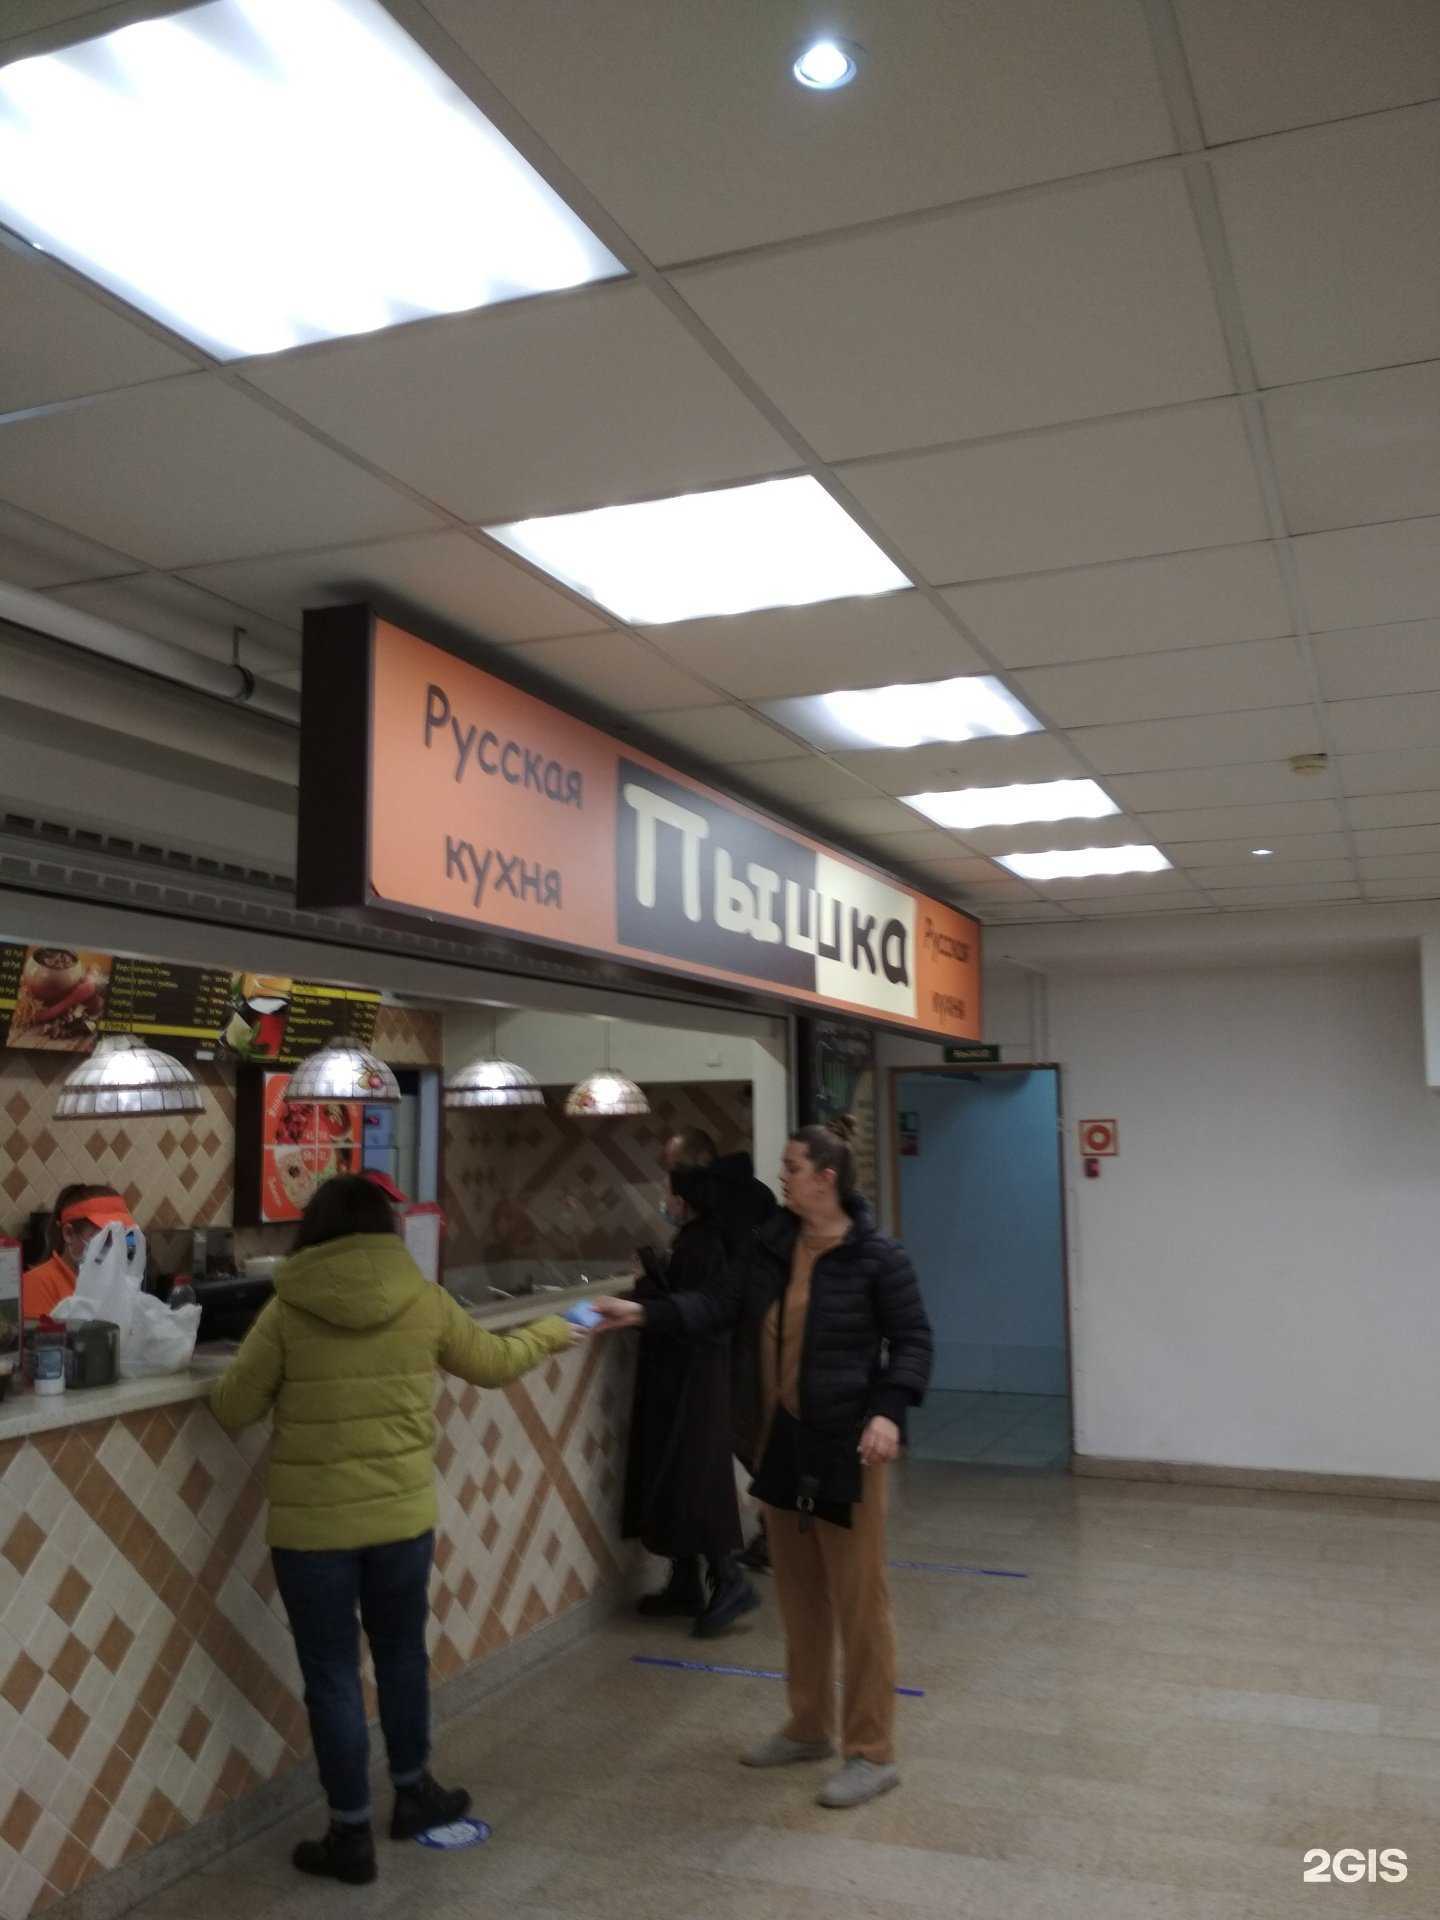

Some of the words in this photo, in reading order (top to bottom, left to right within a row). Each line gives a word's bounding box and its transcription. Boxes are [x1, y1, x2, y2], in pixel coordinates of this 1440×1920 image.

[424, 684, 583, 809] Русская
[445, 835, 563, 909] кухня
[623, 783, 909, 988] Пышка
